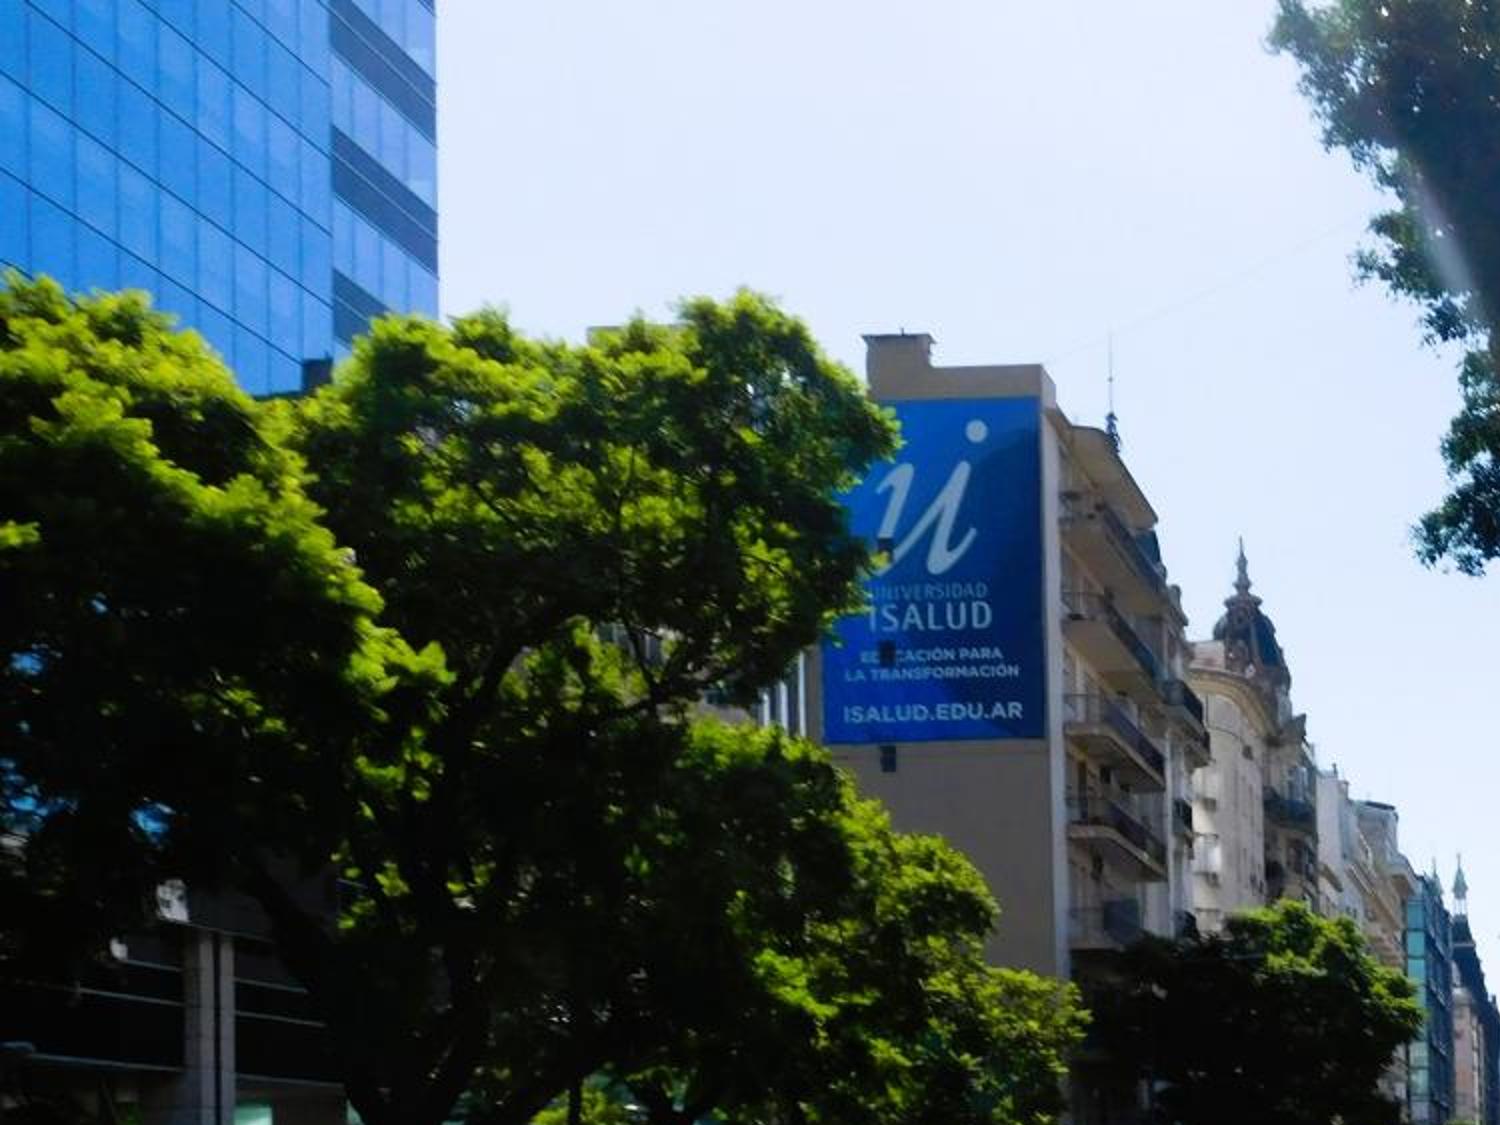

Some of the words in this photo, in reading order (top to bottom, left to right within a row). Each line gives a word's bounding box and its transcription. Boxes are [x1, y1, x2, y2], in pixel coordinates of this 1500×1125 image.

[860, 647, 956, 664] EDCACIÓN
[959, 646, 1004, 660] PARA
[845, 668, 866, 682] LA
[871, 663, 1020, 681] TRANSFORMACIÓN
[843, 701, 1024, 724] ISALUD.EDU.AR
